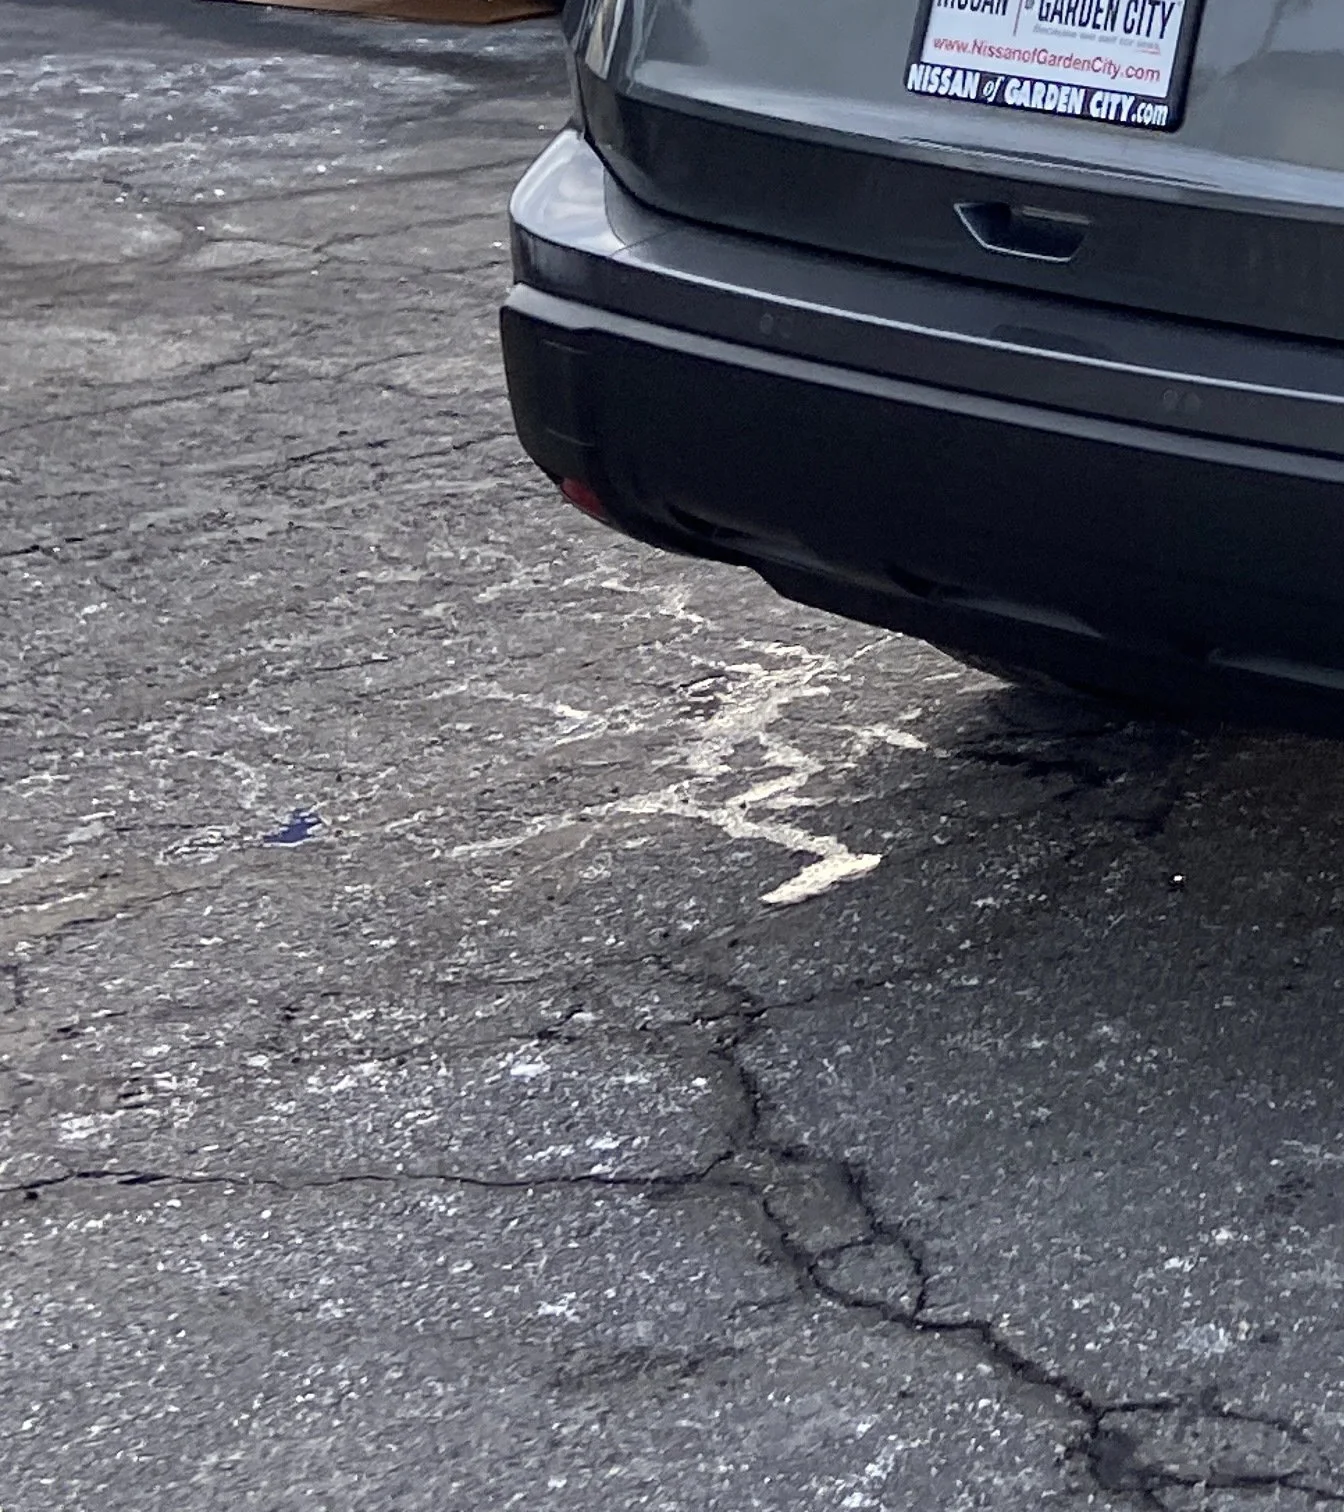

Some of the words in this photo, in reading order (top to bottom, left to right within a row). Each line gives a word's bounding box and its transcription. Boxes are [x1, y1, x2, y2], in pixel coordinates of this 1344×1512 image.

[933, 37, 1160, 82] www.NissanofGardenCity.com
[907, 63, 981, 100] NISSAN
[983, 75, 1005, 104] of
[1004, 77, 1086, 115] GARDEN
[1089, 90, 1169, 127] CITY.com
